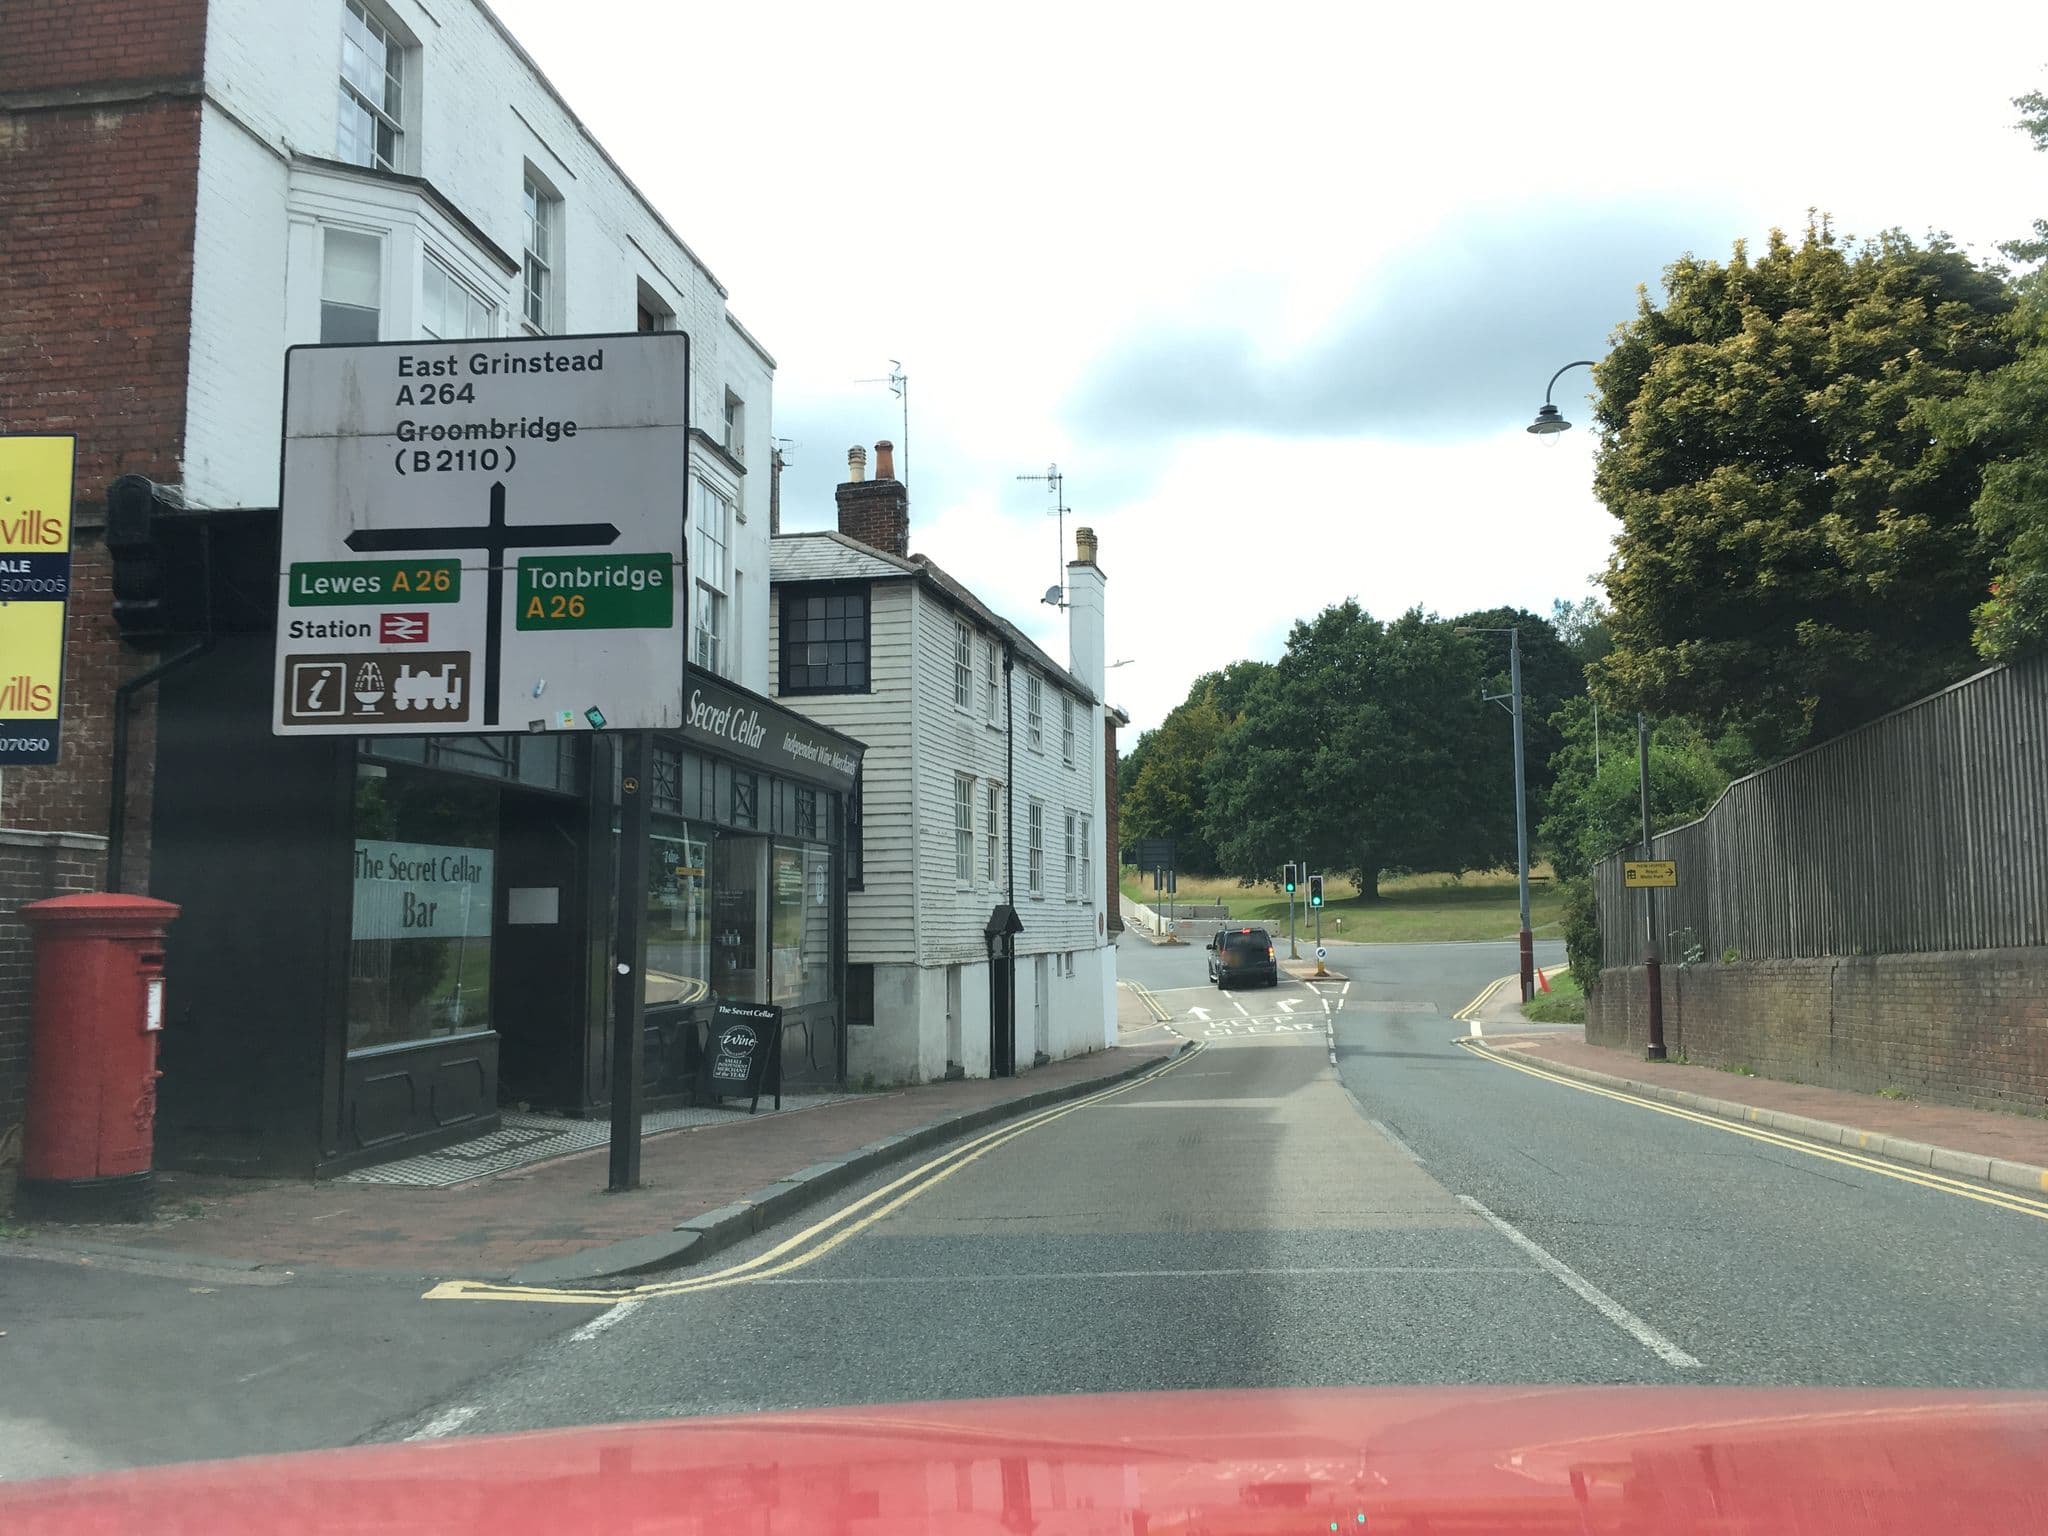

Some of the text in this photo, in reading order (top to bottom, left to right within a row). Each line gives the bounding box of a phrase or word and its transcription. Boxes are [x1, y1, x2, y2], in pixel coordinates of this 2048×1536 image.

[398, 349, 604, 377] East Grinstead
[395, 382, 476, 406] A264
[396, 416, 577, 443] Groombridge
[394, 445, 517, 476] (B2110)
[300, 569, 451, 595] Lewes A26
[526, 565, 663, 592] Tonbridge
[526, 595, 586, 619] A26
[288, 619, 372, 640] Station
[686, 689, 768, 750] Secret Cellar
[782, 731, 819, 761] Independent
[817, 746, 832, 768] Wine
[352, 848, 482, 884] The Secret Cellar
[402, 891, 438, 928] Bar
[719, 1005, 775, 1018] The Secret Cellar
[1209, 1016, 1293, 1028] KEEP
[720, 1034, 755, 1047] Wine
[1203, 1023, 1314, 1036] CLEAR
